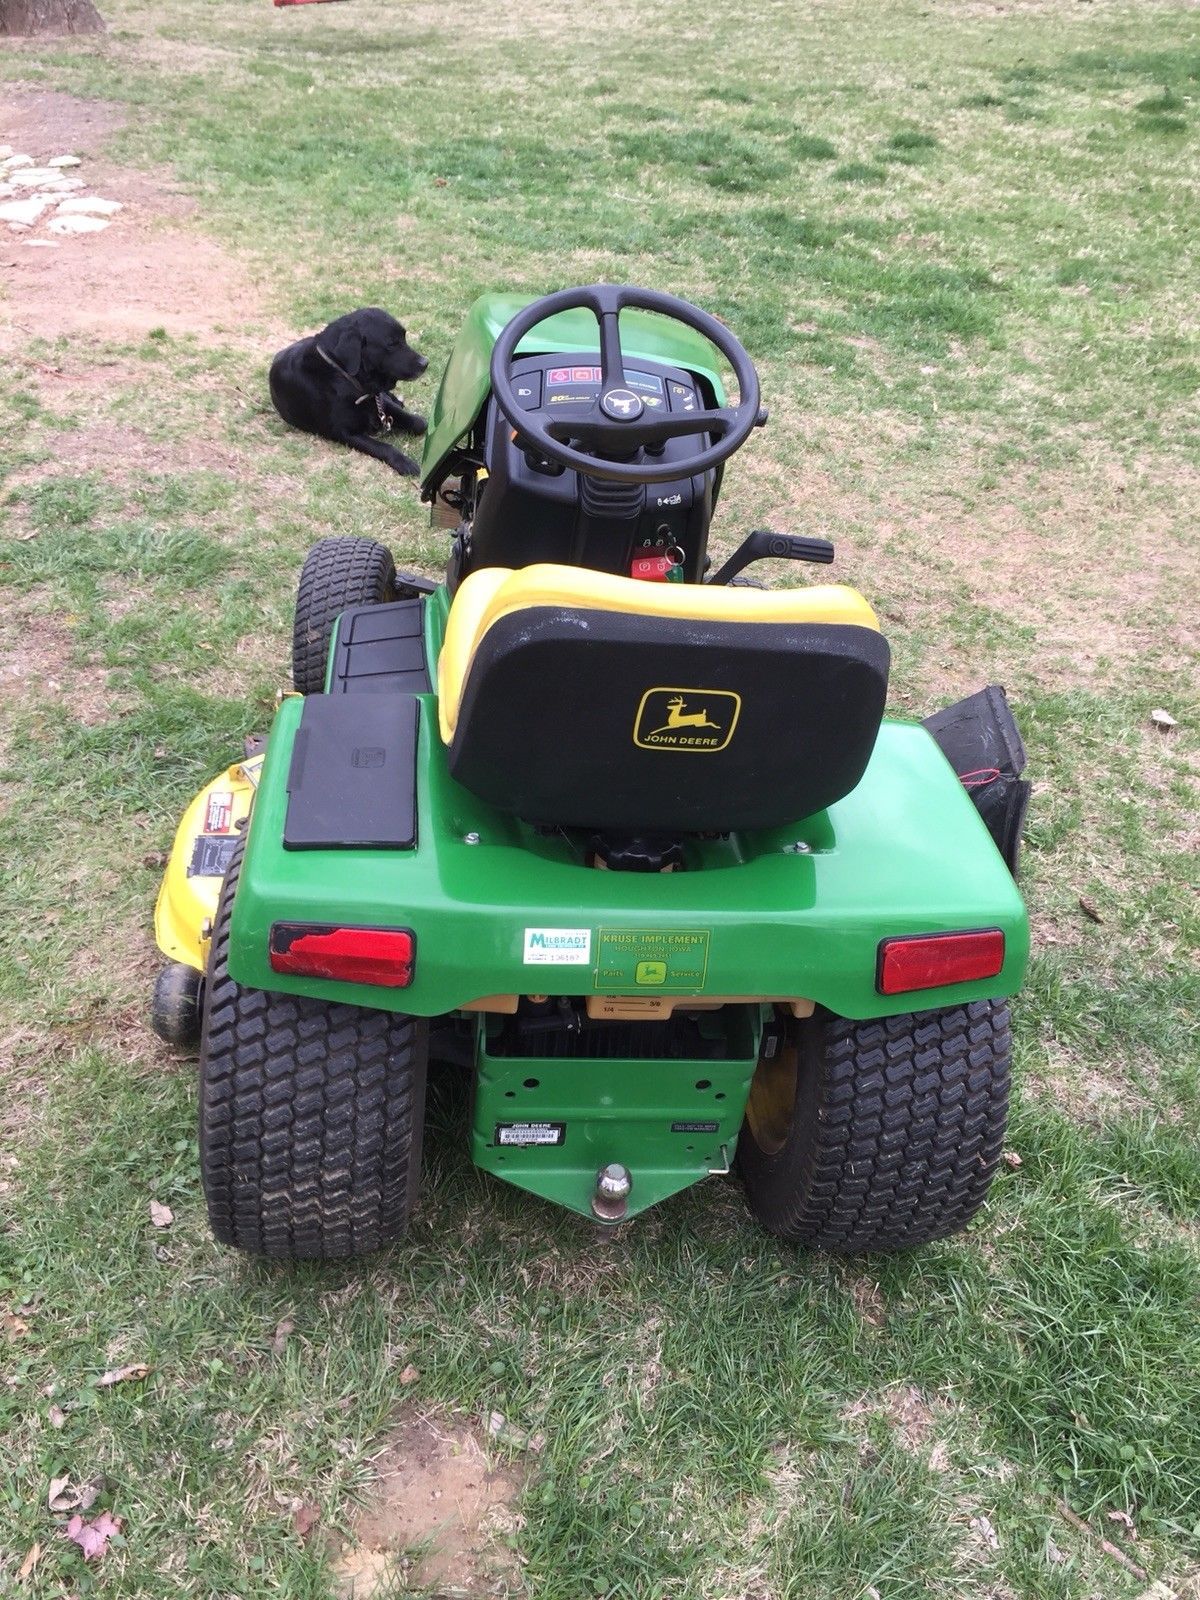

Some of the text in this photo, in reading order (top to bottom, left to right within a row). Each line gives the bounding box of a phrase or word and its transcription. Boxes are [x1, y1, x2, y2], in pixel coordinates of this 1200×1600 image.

[643, 734, 718, 746] JOHN DEERE
[529, 933, 587, 948] MILBRADT
[603, 935, 704, 944] KRUSE IMPLEMENT
